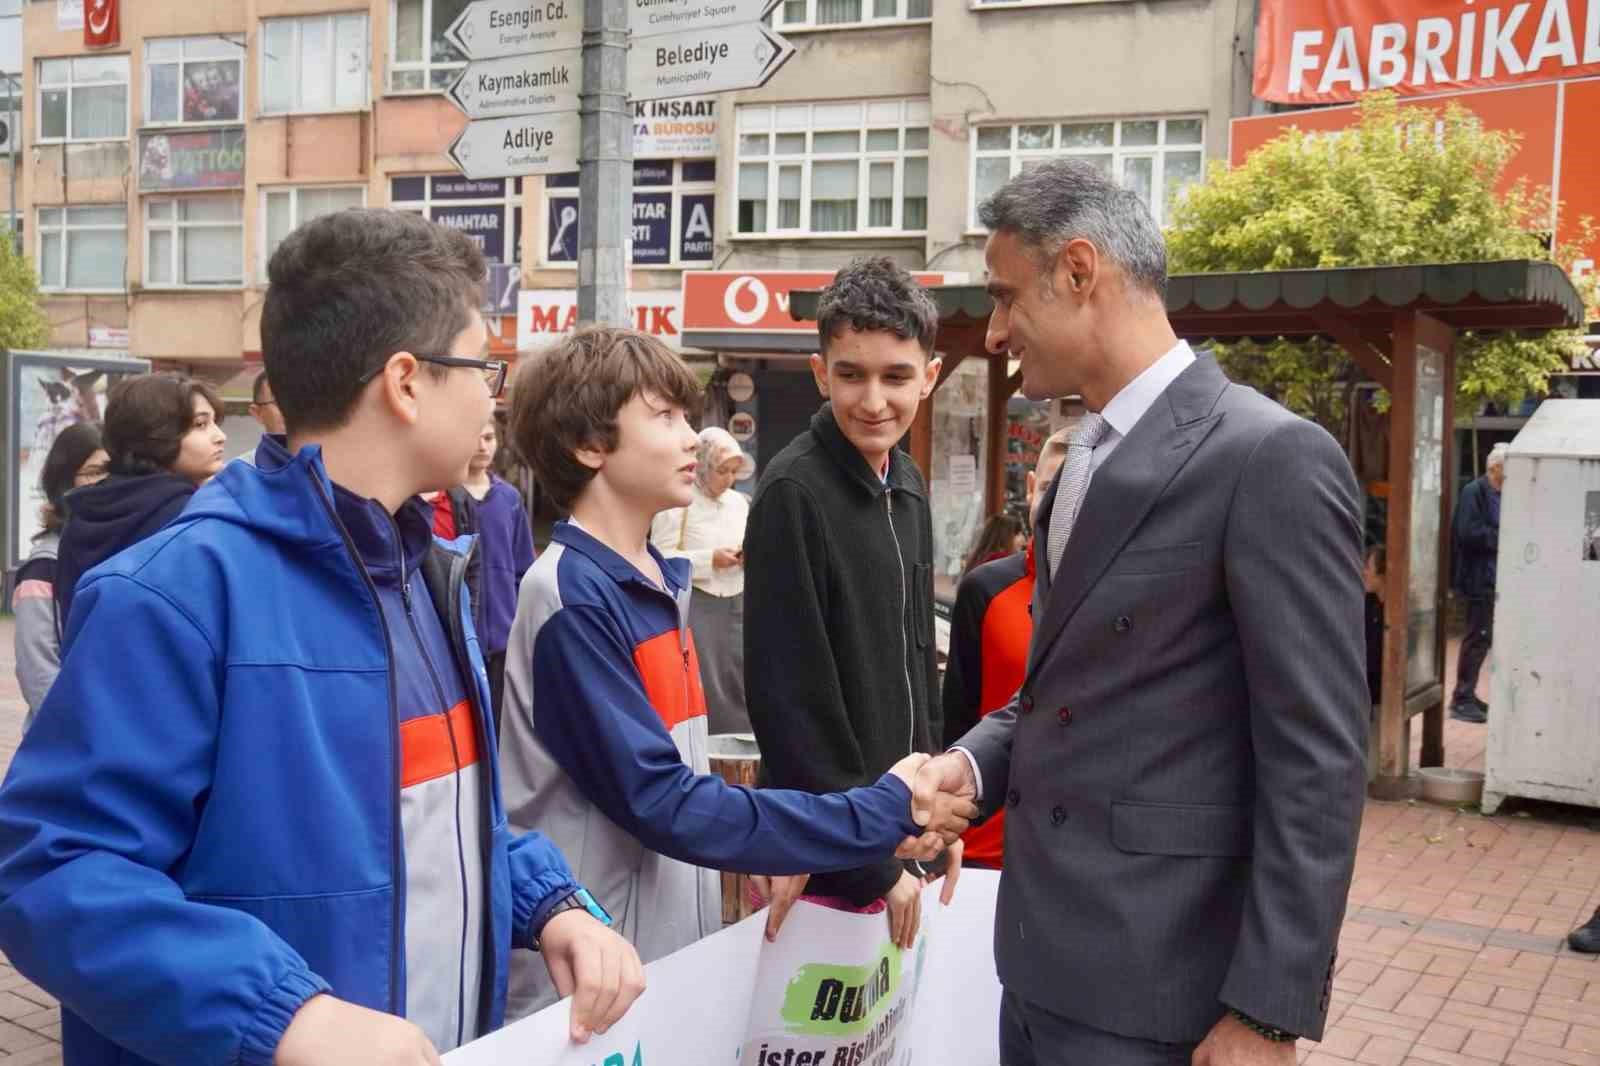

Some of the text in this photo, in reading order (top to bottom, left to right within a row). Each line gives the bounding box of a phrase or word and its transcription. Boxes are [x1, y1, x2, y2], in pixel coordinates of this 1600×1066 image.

[489, 1, 568, 29] Esengin Cd.
[648, 9, 701, 25] Cumhuriyet
[704, 4, 737, 17] Square
[656, 41, 729, 67] Belediye
[479, 65, 569, 95] Kaymakamlık
[656, 70, 712, 87] Municipality
[503, 127, 554, 151] Adliye
[685, 203, 713, 239] A
